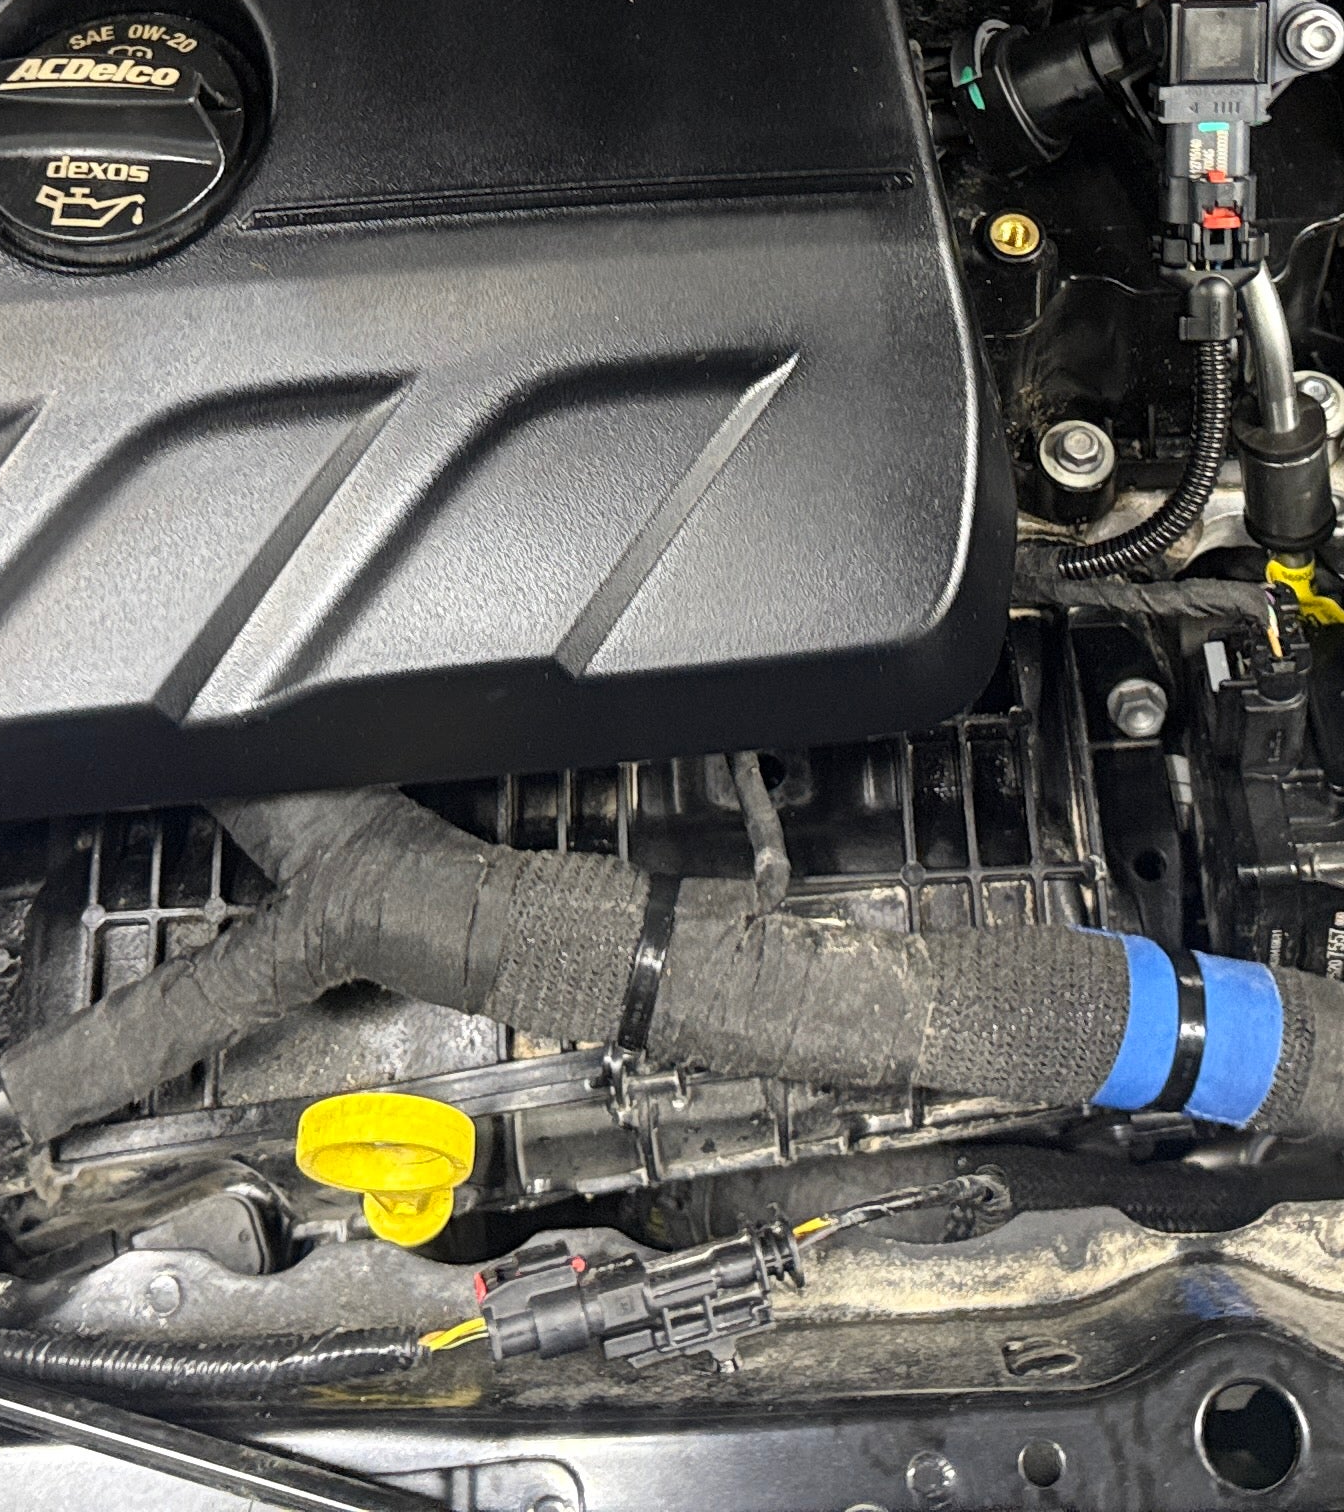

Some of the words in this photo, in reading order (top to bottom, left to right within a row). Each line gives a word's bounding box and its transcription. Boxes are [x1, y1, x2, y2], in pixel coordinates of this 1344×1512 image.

[69, 25, 116, 50] SAE
[127, 23, 198, 54] 0W-20
[5, 57, 181, 87] ACDelco
[46, 155, 151, 183] dexos
